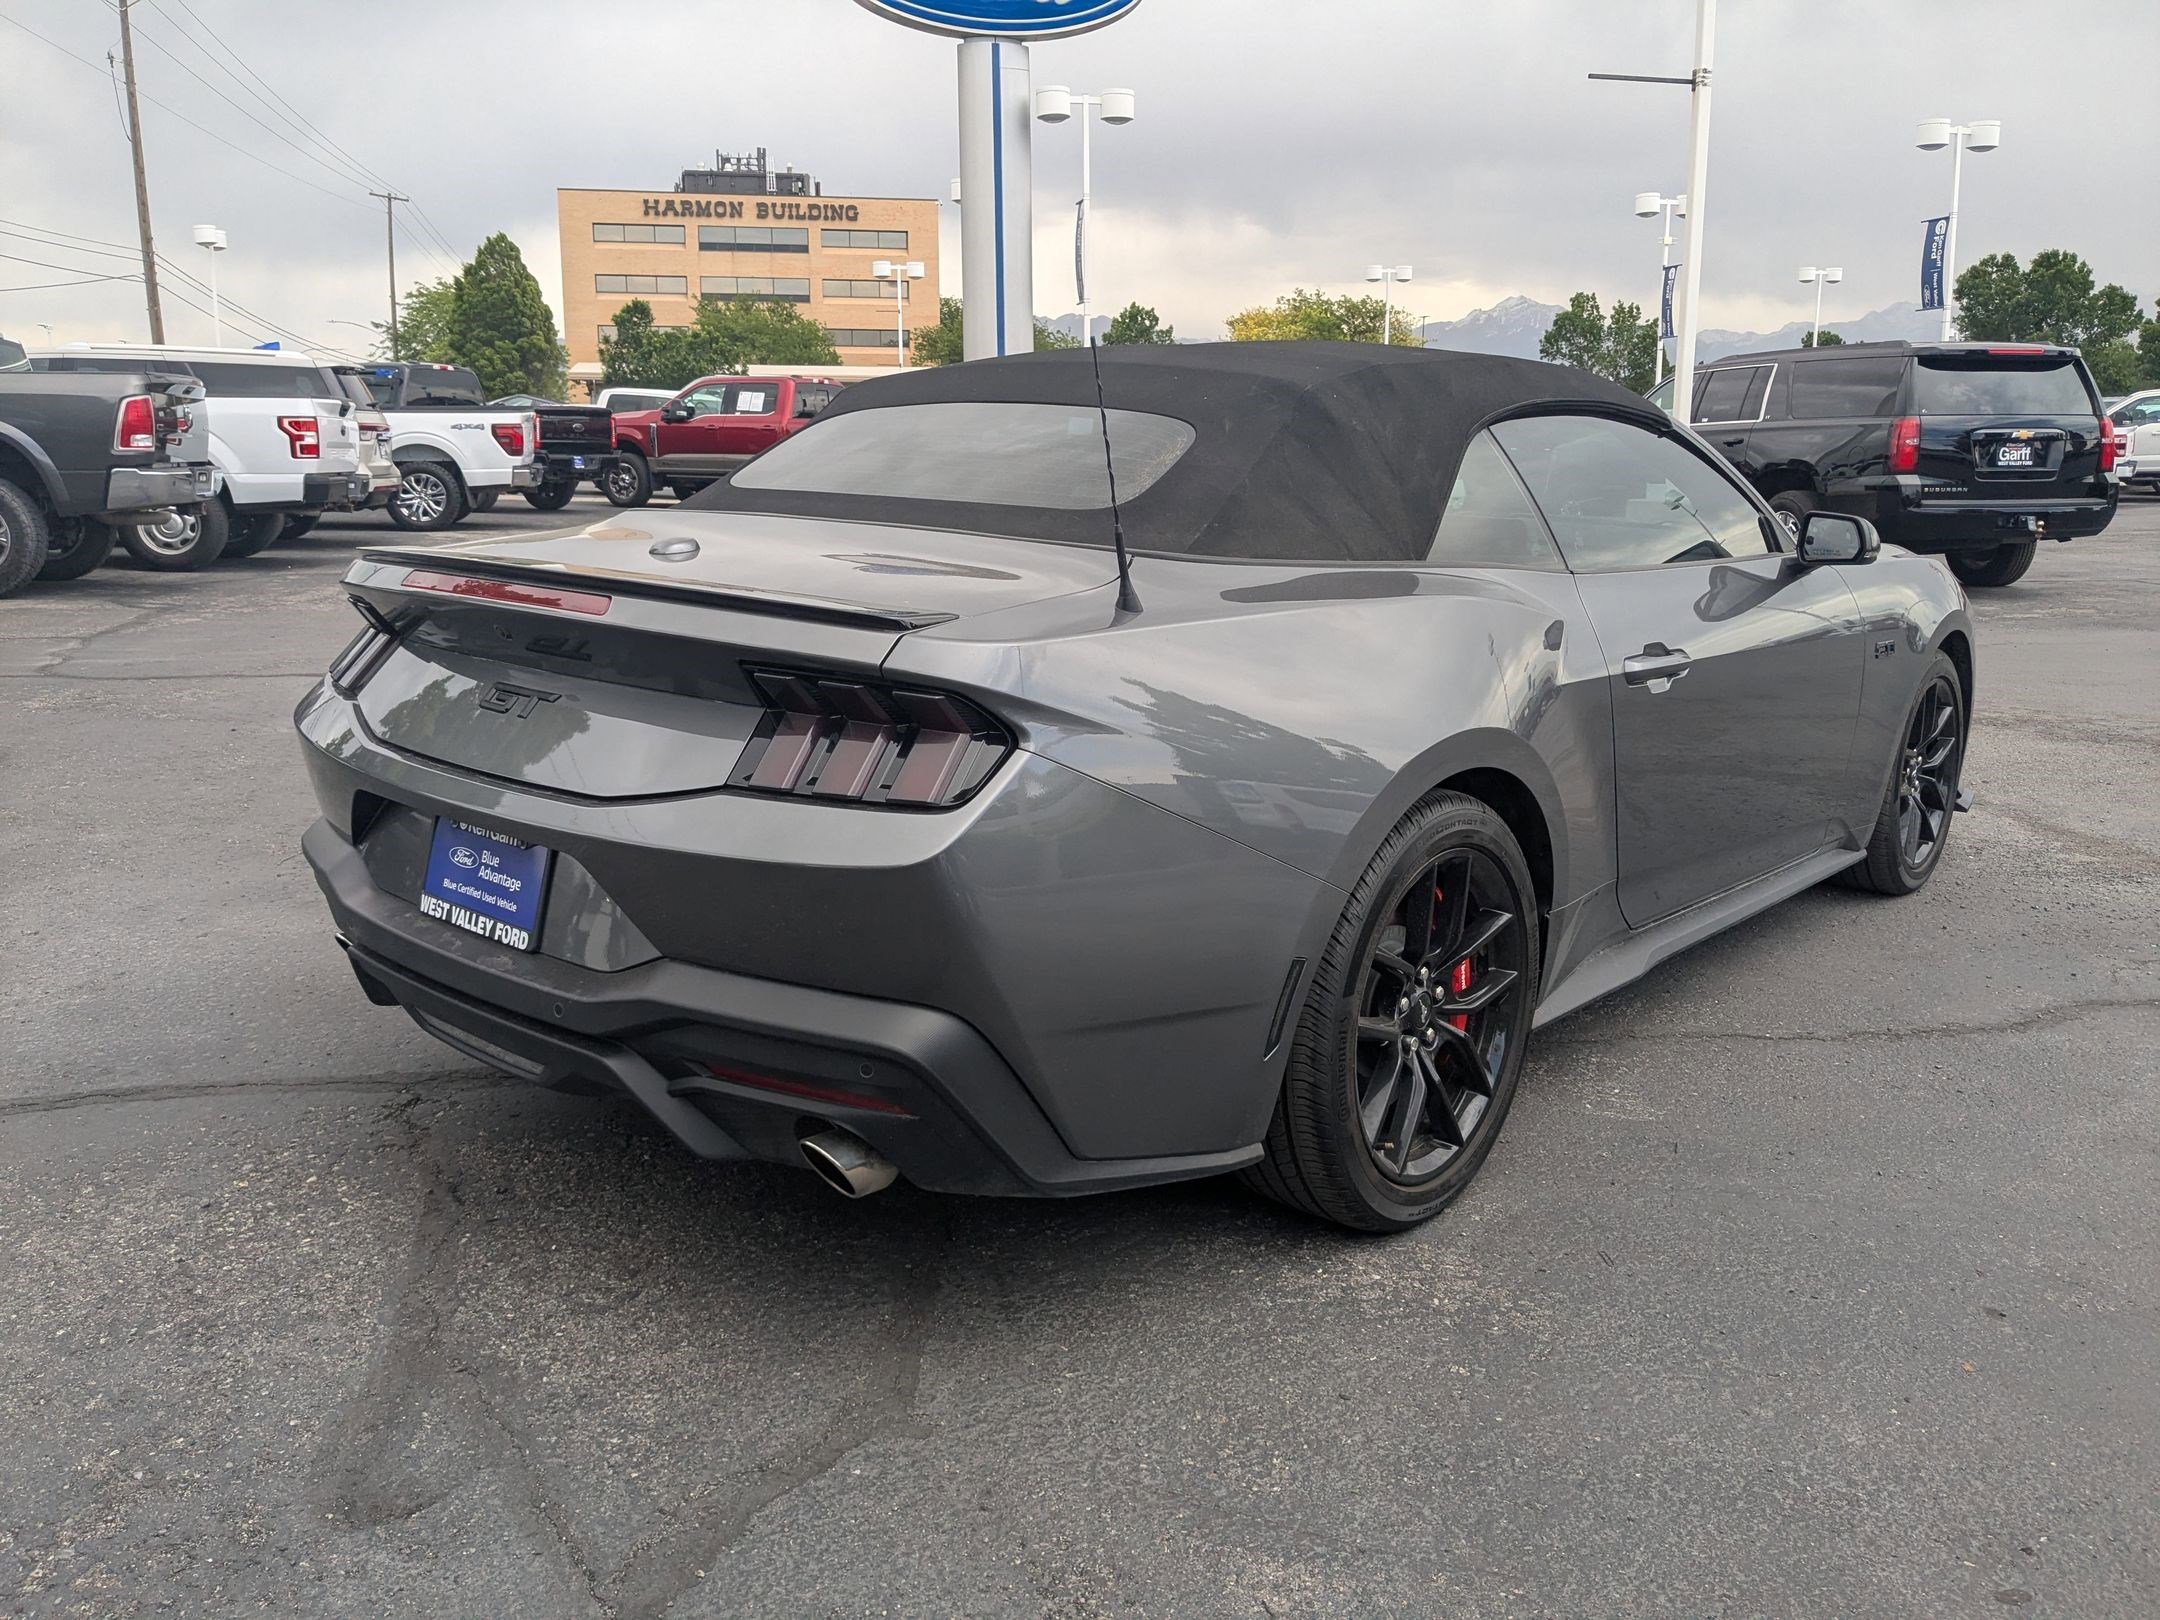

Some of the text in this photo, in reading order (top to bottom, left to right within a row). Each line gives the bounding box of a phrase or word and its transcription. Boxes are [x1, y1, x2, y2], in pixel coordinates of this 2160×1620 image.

[643, 198, 860, 222] HARMON BUILDING
[1931, 236, 1940, 259] Ford
[1999, 447, 2031, 461] Garff
[480, 681, 562, 719] GT
[454, 848, 500, 867] Ford Blue
[478, 866, 522, 892] Advantage
[443, 878, 518, 913] Blue Certified Used Vehicle
[420, 894, 529, 950] WEST VALLEY FORD
